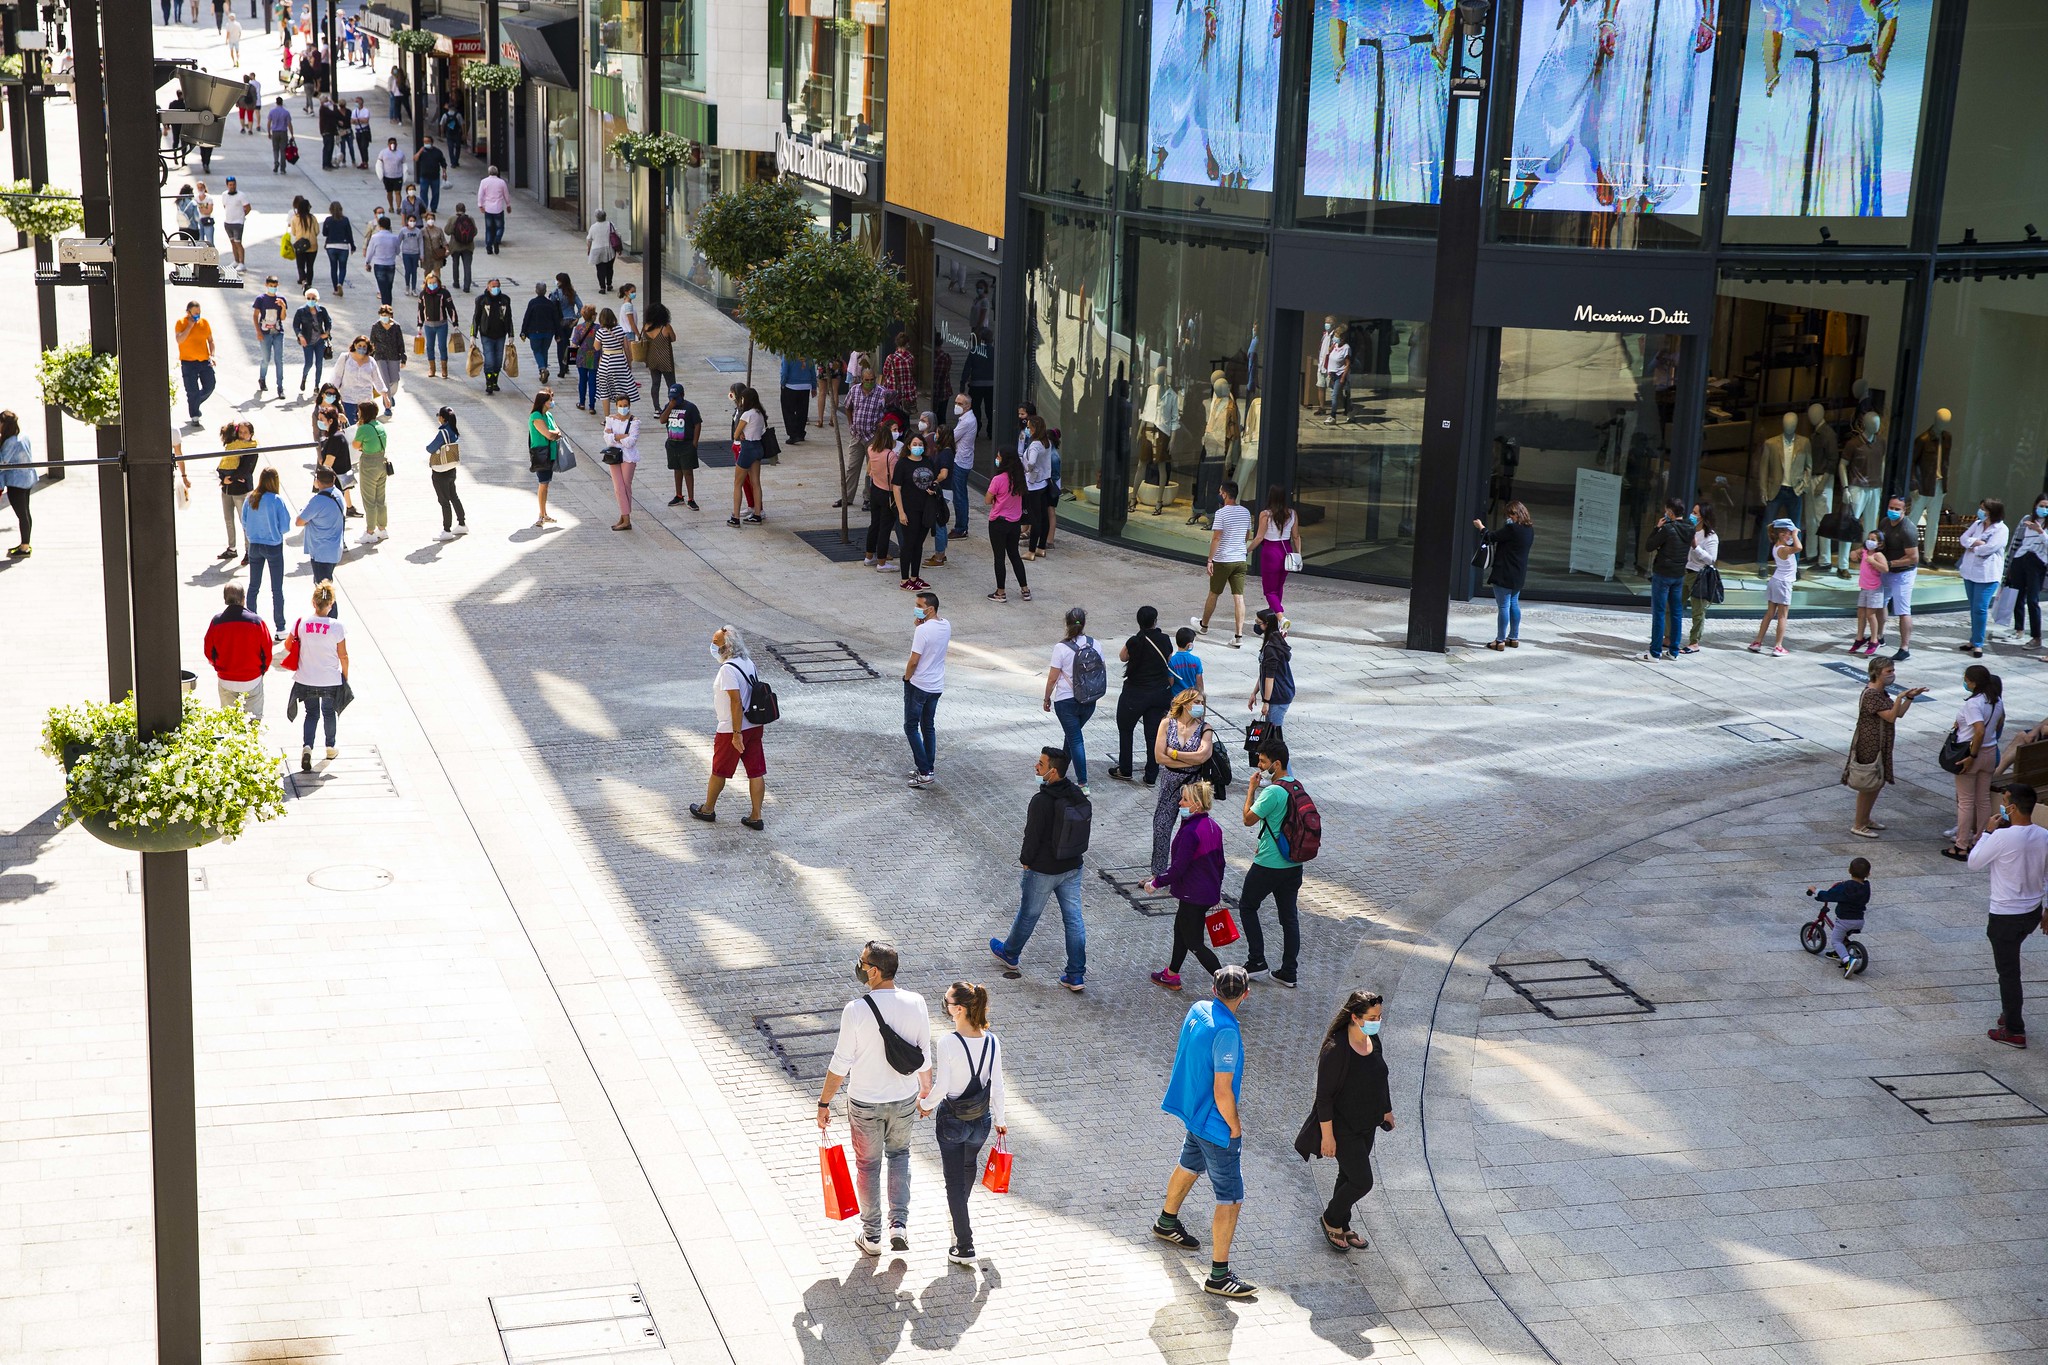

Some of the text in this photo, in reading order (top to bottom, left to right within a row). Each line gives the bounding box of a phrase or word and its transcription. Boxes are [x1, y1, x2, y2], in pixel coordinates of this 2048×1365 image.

[1574, 304, 1690, 325] Massimo Dutti
[940, 320, 969, 350] Massimo
